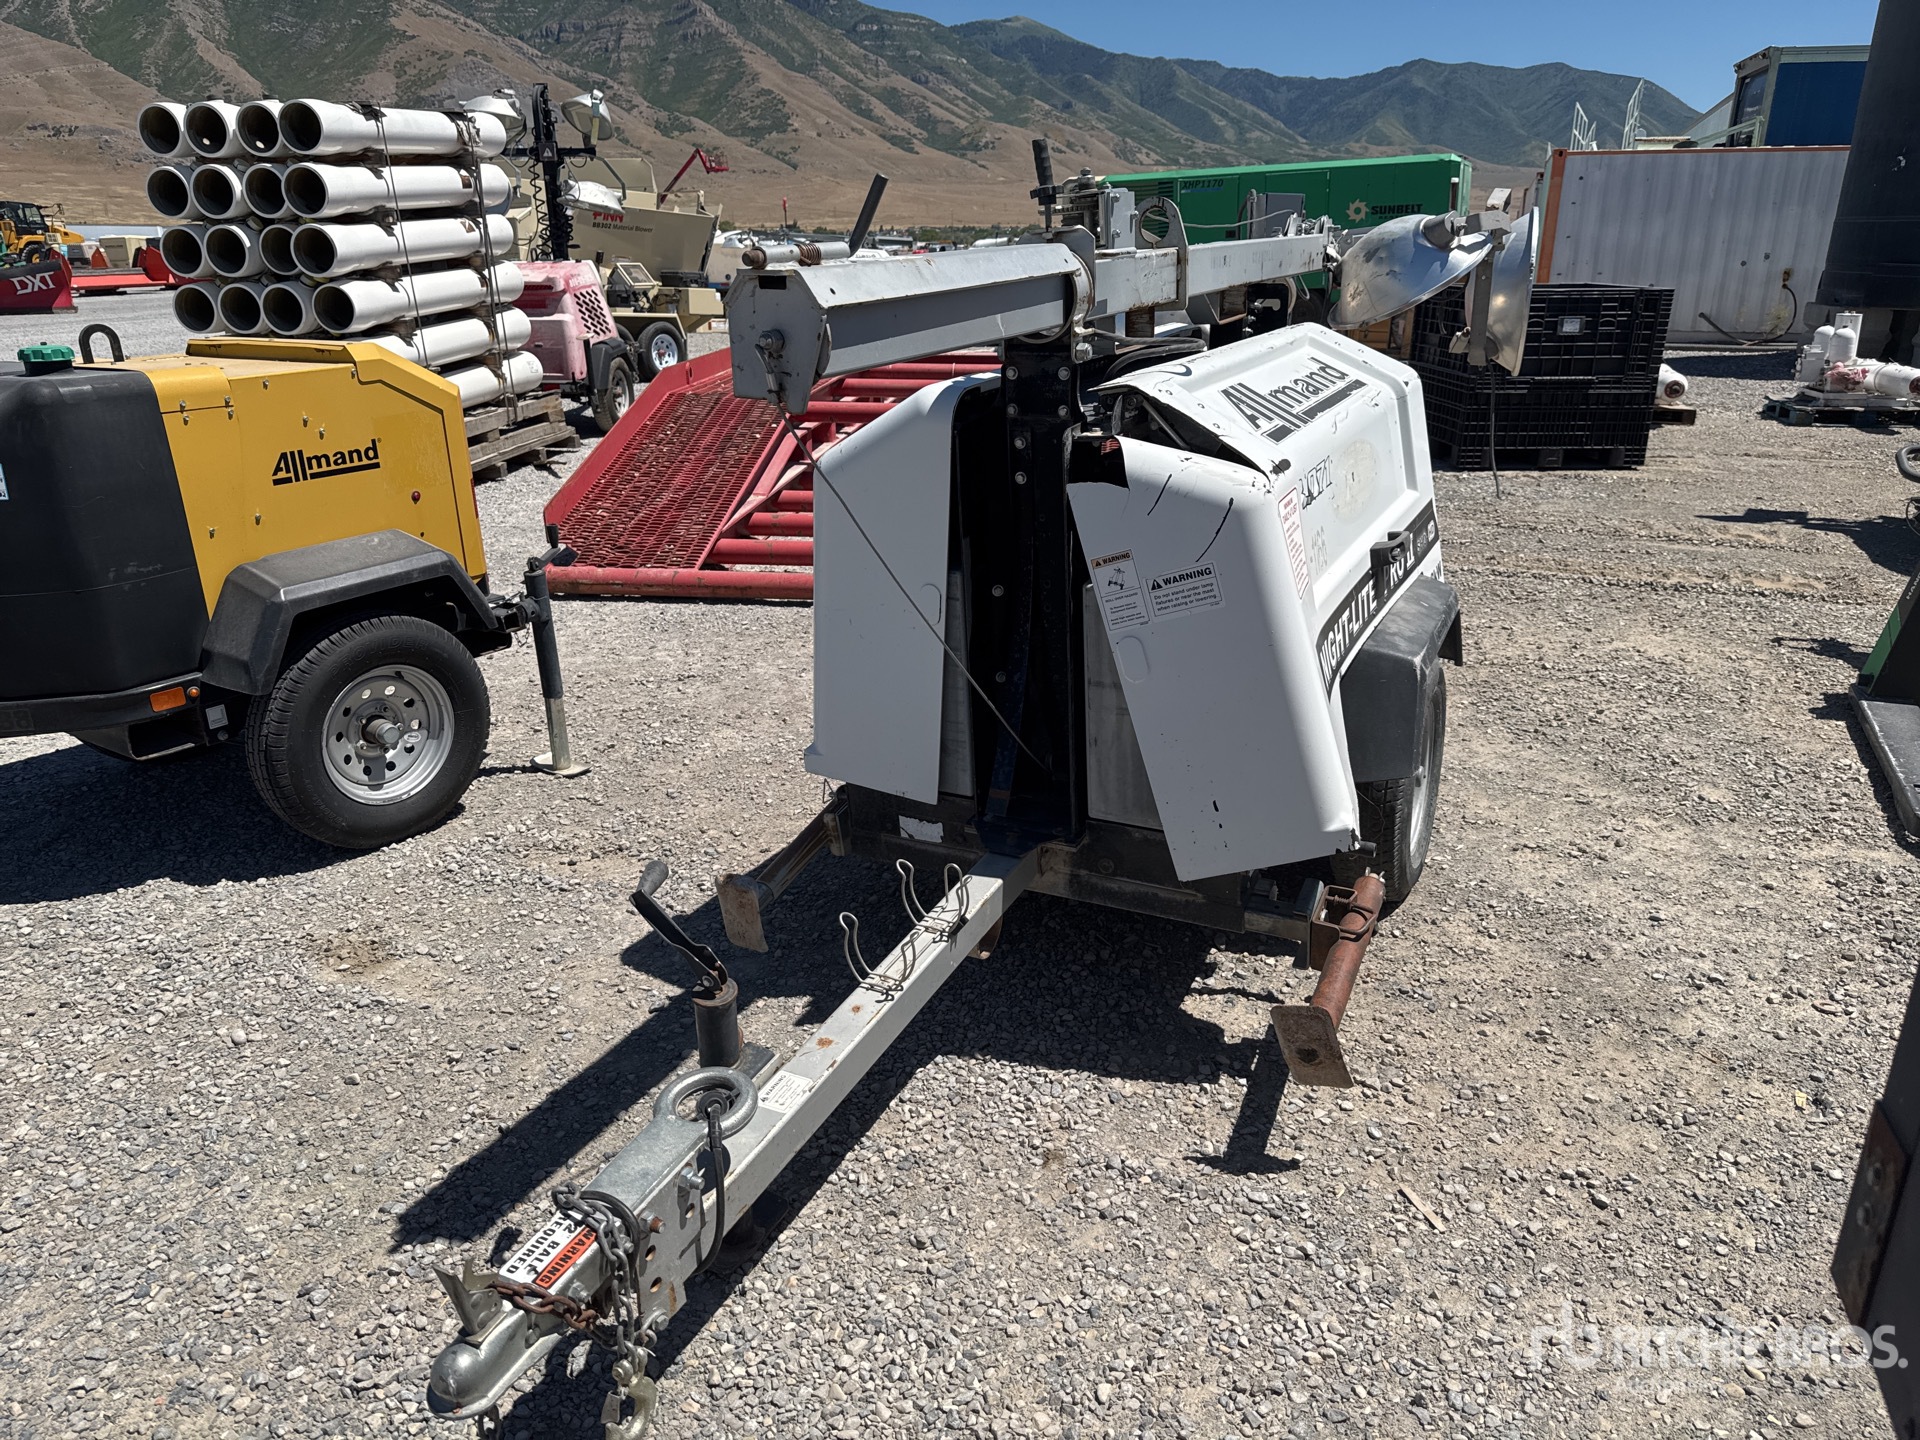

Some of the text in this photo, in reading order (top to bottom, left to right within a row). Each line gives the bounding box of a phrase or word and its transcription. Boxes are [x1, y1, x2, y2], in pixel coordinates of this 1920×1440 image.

[1182, 179, 1224, 189] XHP1170
[1371, 203, 1423, 215] SUNBELT
[612, 224, 634, 232] Material
[634, 225, 654, 233] Blower
[9, 271, 56, 296] DXT
[1219, 356, 1351, 432] Allmand
[271, 438, 380, 484] Allmand
[1101, 552, 1131, 565] WARNING
[1162, 567, 1212, 586] WARNING
[1171, 601, 1188, 609] raising
[1195, 594, 1217, 603] lowering
[766, 1074, 787, 1096] WARNING
[525, 1241, 561, 1274] BALL
[539, 1228, 596, 1285] WARNING
